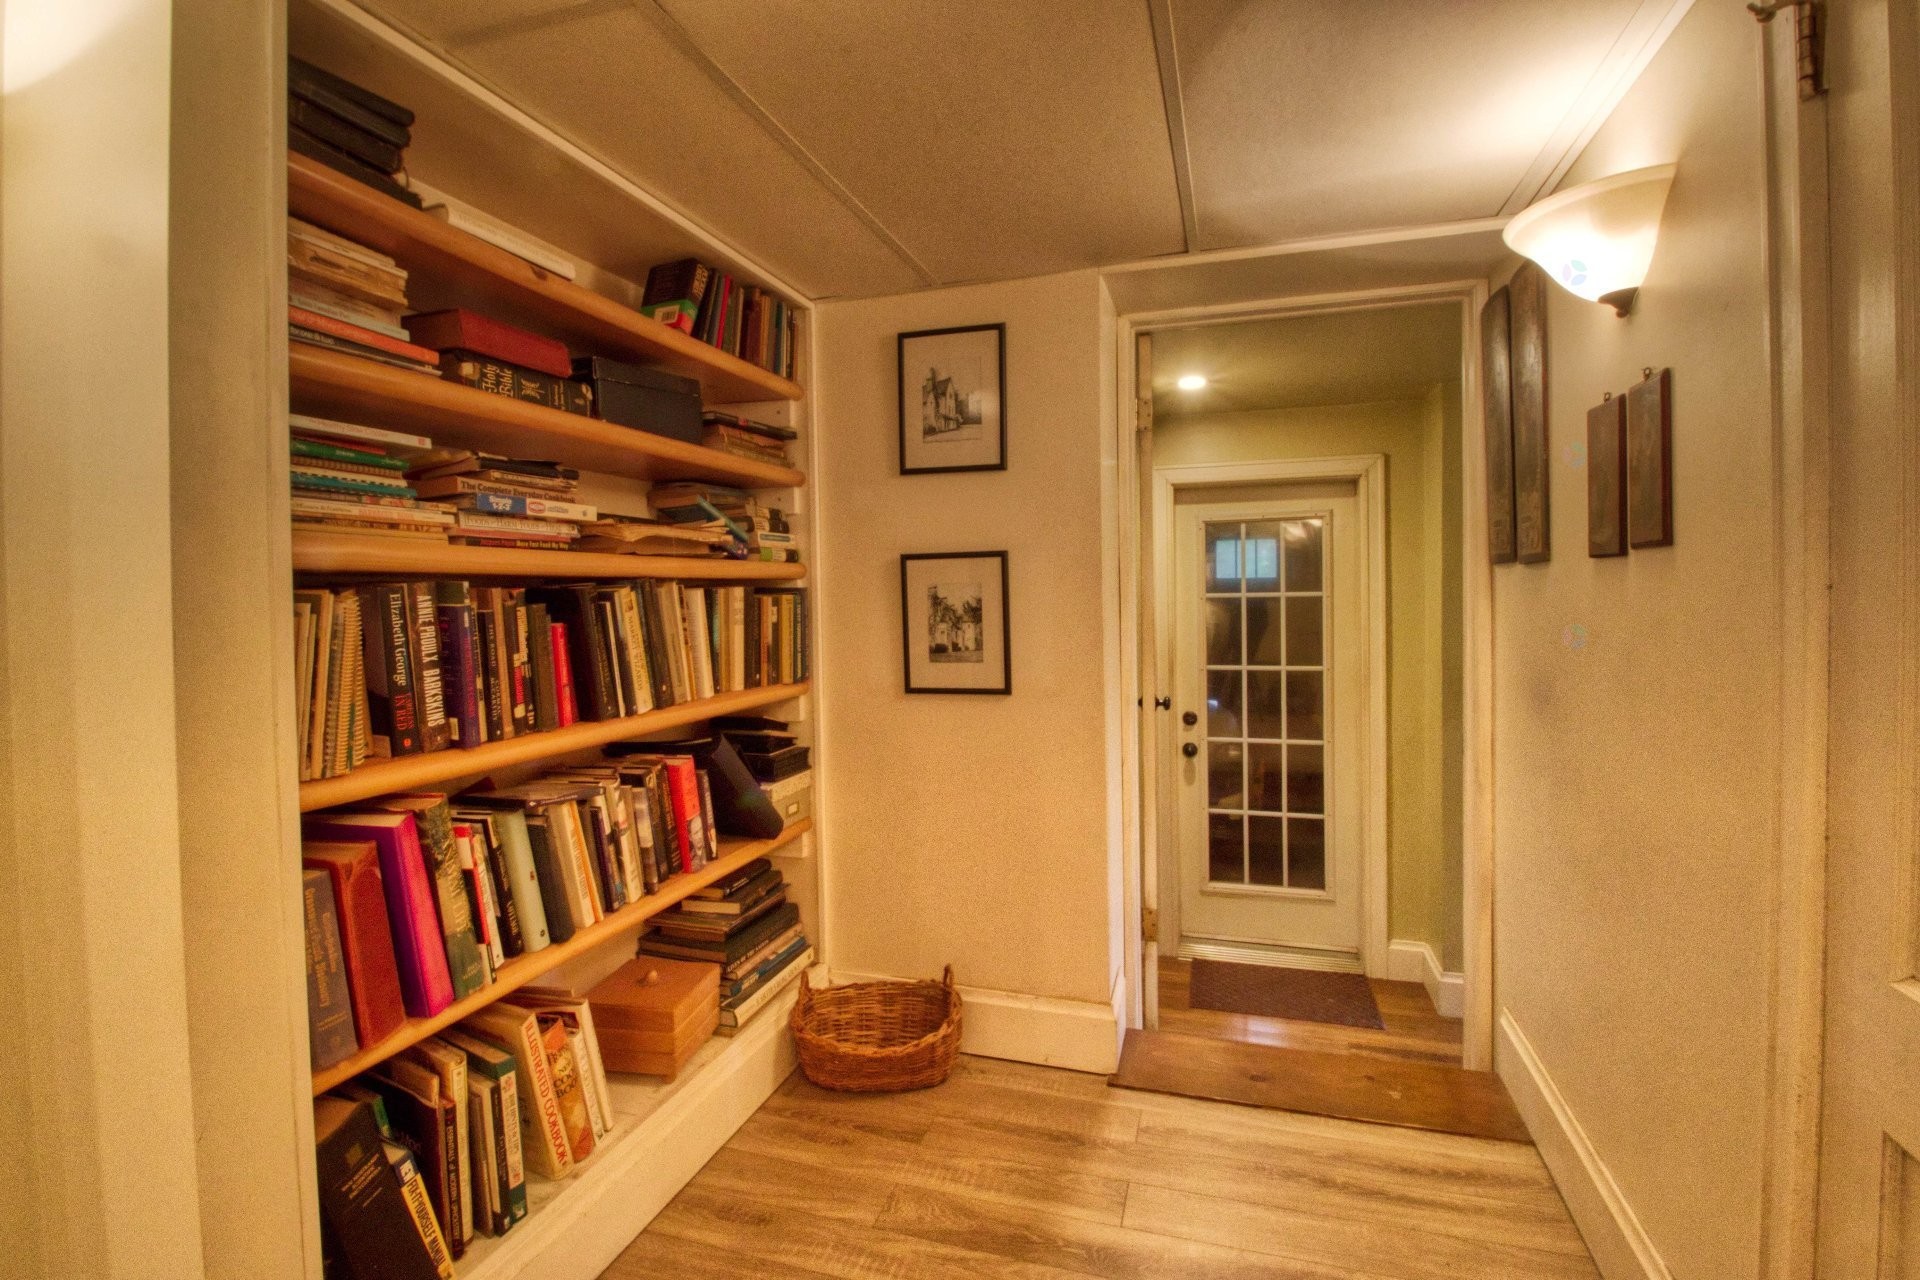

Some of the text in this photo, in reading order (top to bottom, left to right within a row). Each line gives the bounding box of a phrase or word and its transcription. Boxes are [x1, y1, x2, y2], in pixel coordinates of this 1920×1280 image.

[482, 363, 500, 393] Holy
[499, 368, 514, 398] Bible
[461, 480, 476, 492] The
[477, 483, 512, 495] Complete
[513, 487, 543, 499] Everyday
[389, 593, 406, 686] Elizabeth George
[488, 624, 497, 667] THE ROAD
[627, 616, 637, 649] MARKET
[633, 652, 642, 690] WIZARDS
[417, 595, 445, 727] ANNIE PROULX BARKSKINS
[394, 695, 405, 730] IN RED
[525, 1023, 566, 1164] ILLUSTRATED COOKBOOK
[446, 1125, 455, 1162] ESSENTIALS
[427, 1235, 446, 1266] MANUAL
